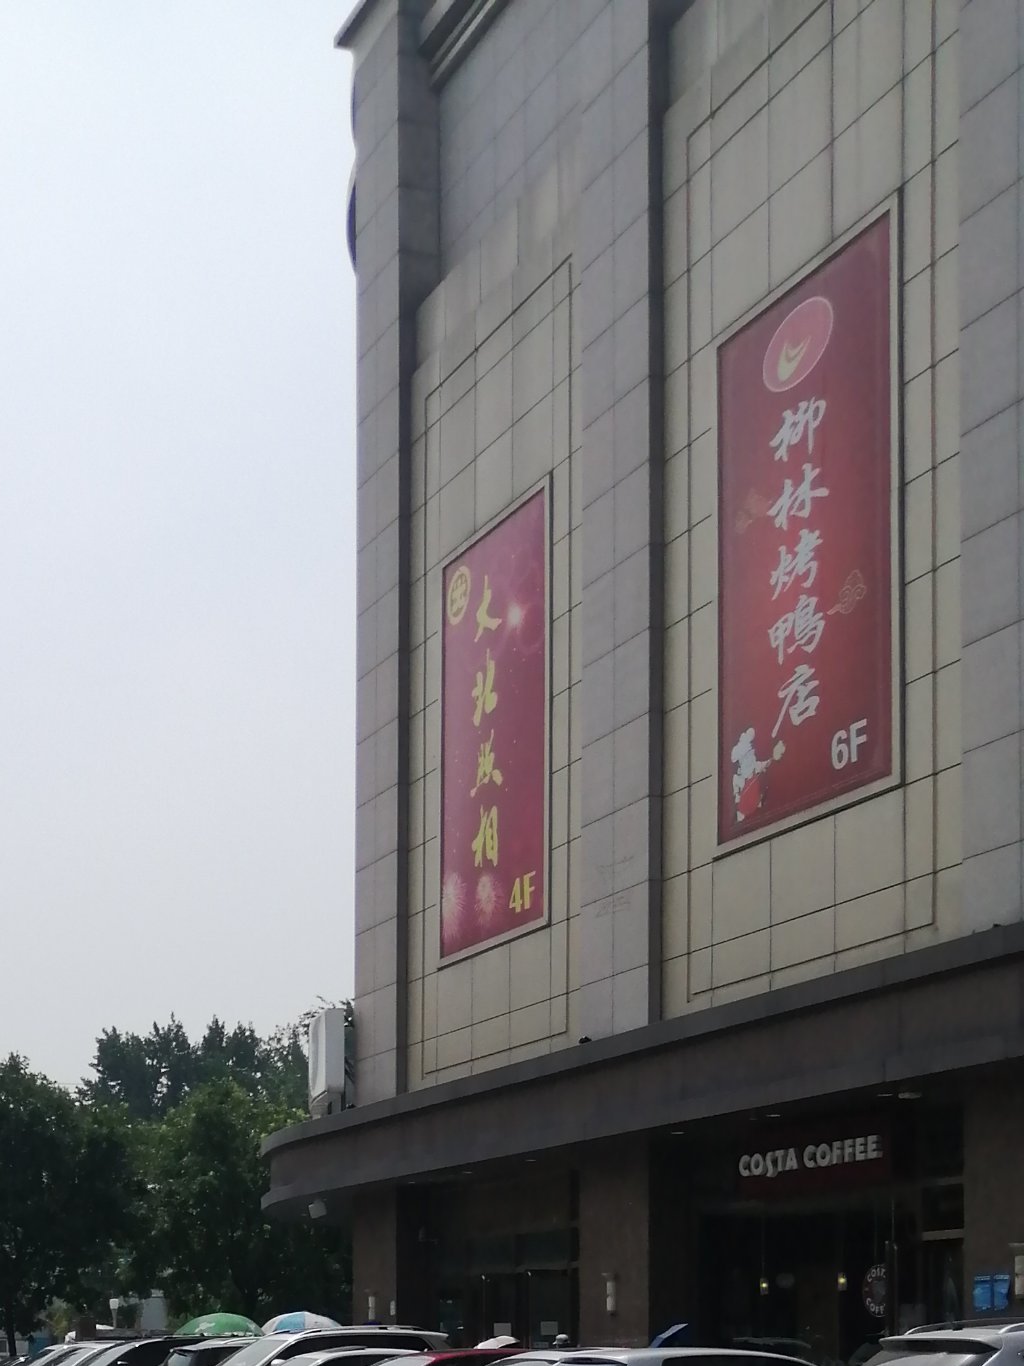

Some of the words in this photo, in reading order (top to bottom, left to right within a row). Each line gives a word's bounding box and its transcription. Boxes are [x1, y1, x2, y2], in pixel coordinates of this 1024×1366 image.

[831, 718, 868, 770] 6F
[509, 871, 536, 913] 4F
[739, 1148, 798, 1177] COSTA
[803, 1134, 883, 1168] COFFEE
[867, 1267, 886, 1282] COST
